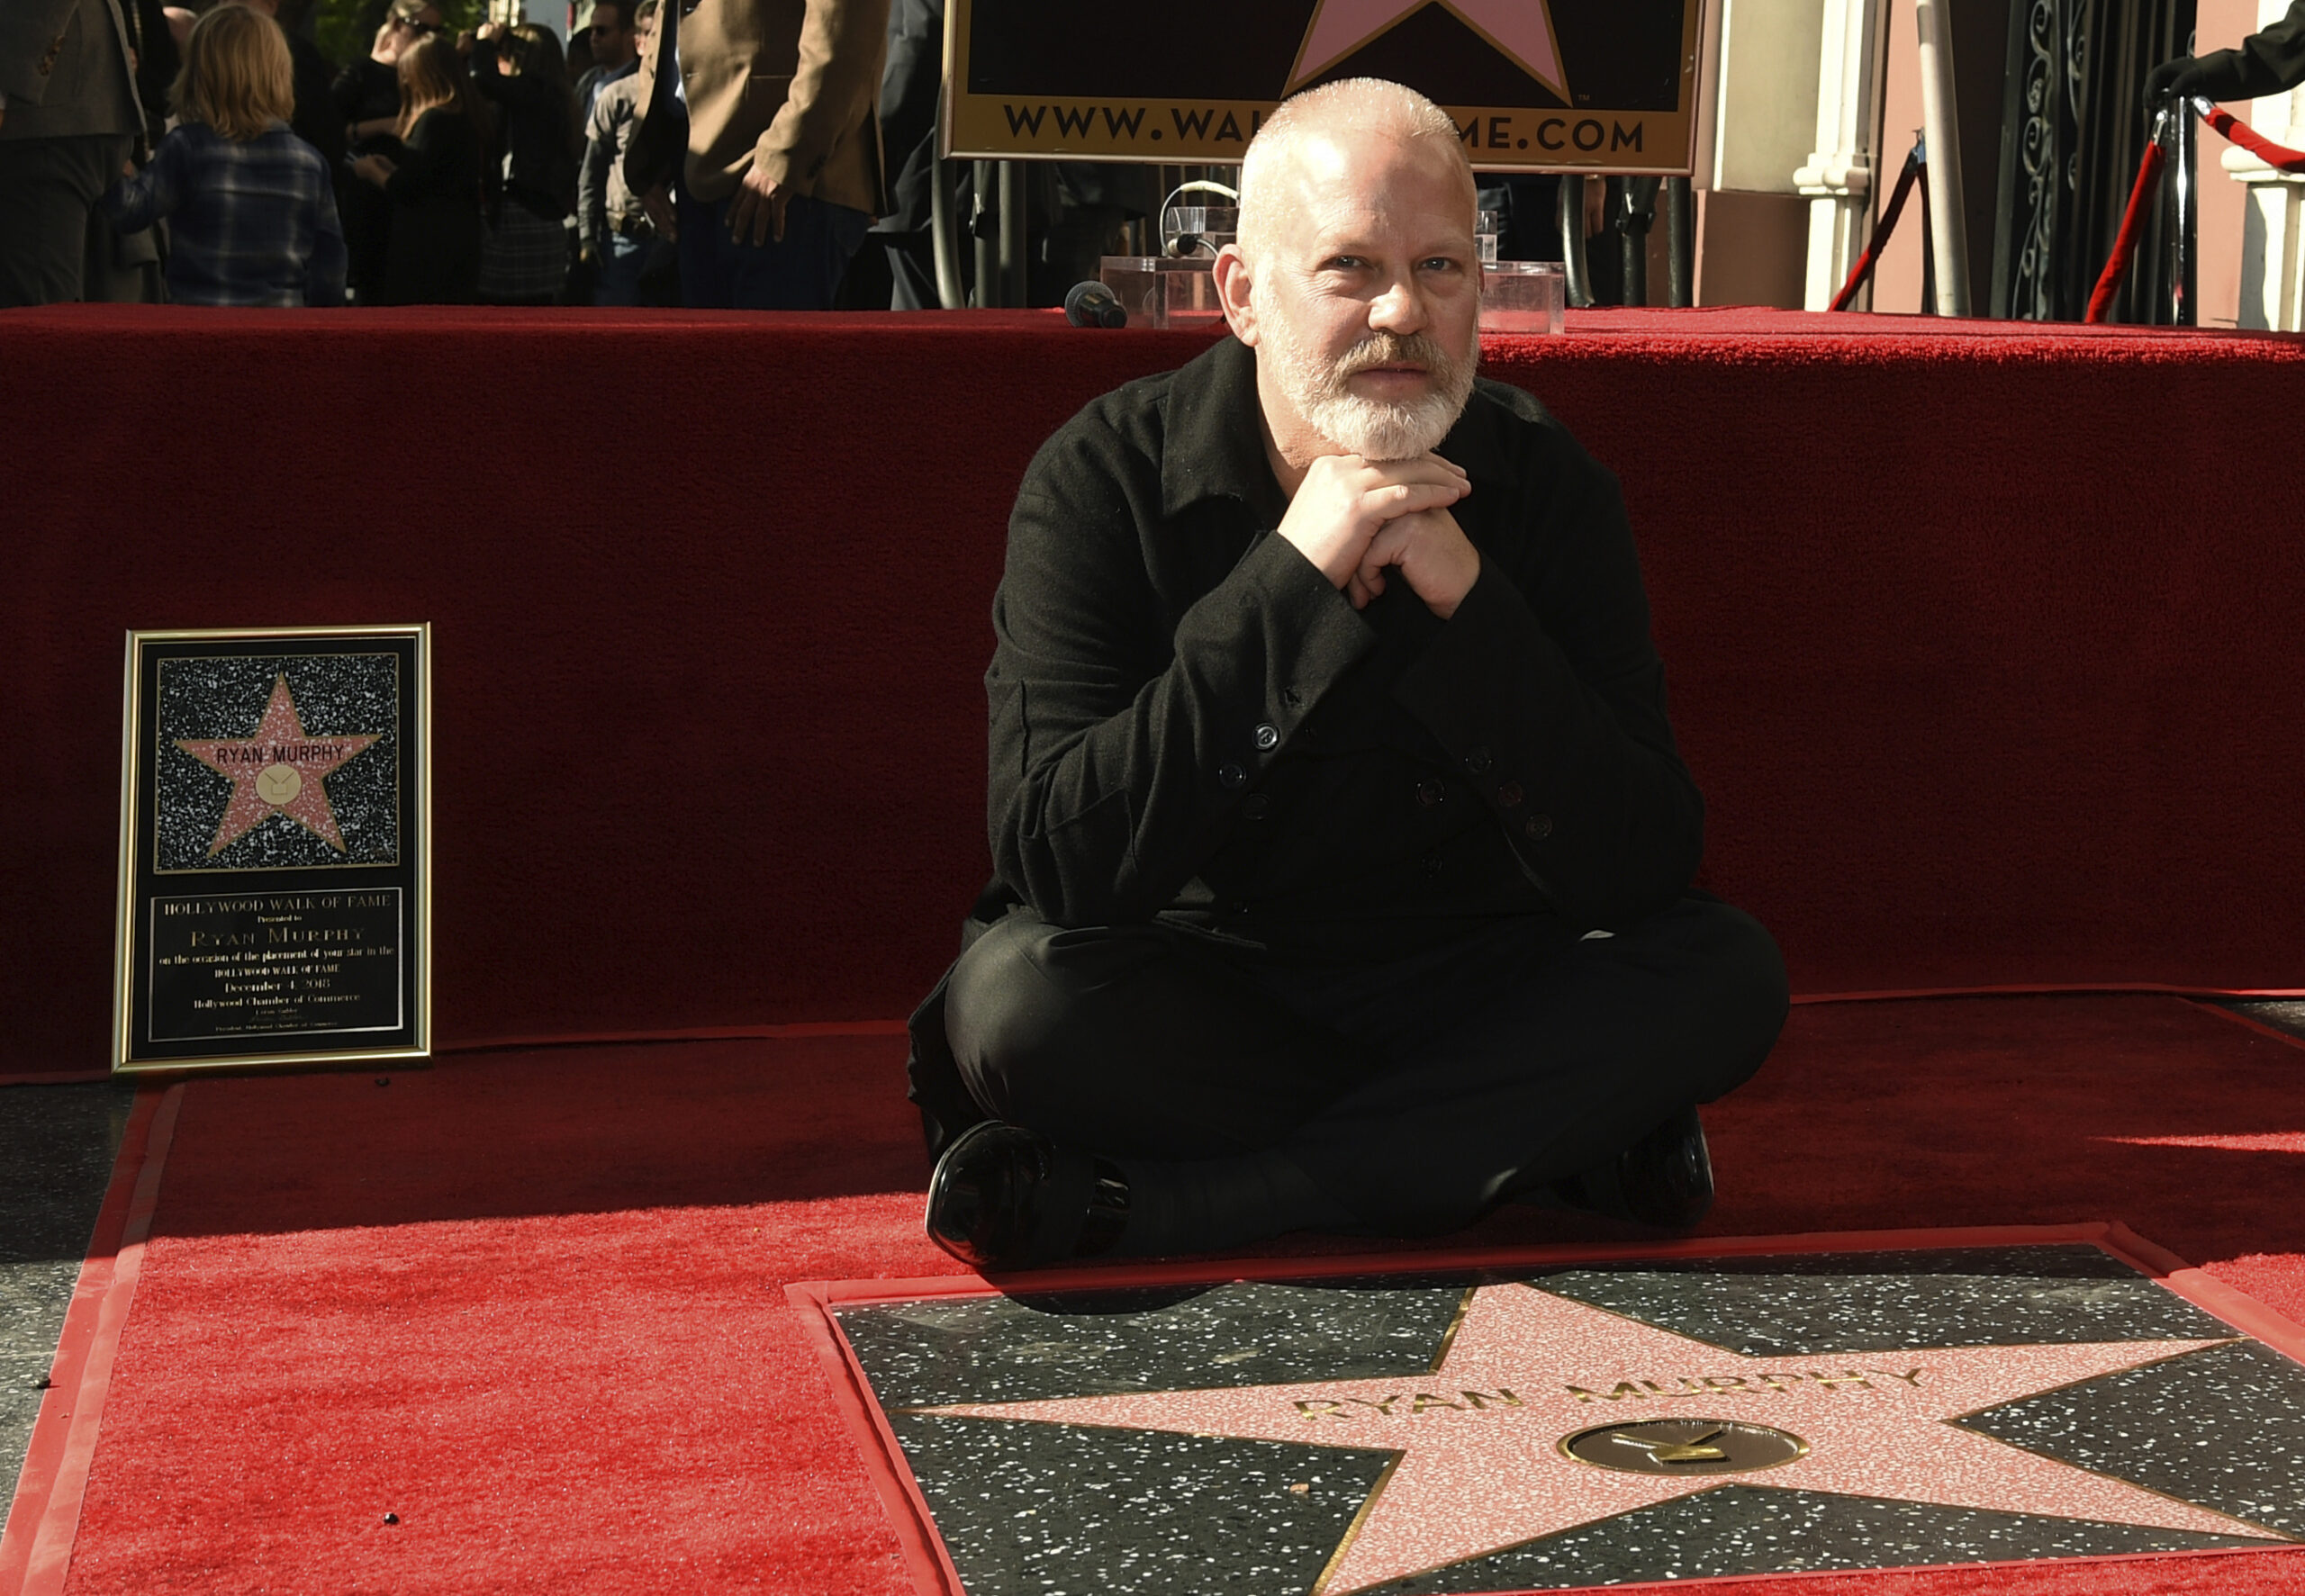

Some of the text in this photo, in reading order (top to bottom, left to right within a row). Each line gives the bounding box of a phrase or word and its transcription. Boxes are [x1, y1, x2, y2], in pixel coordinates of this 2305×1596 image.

[217, 744, 344, 764] RYAN MURPHY
[164, 895, 391, 915] HOLLYWOOD WALK OF FAME
[258, 915, 292, 924] Presented
[159, 946, 394, 966] on the occasion of the placement of your star in the
[214, 968, 270, 978] HOLLYWOOD
[272, 966, 298, 976] WALK
[315, 963, 340, 973] FAME
[224, 980, 281, 994] December
[194, 994, 360, 1010] Hollywood Chamber of Commerce
[1294, 1368, 1923, 1420] RYAN MURPHY
